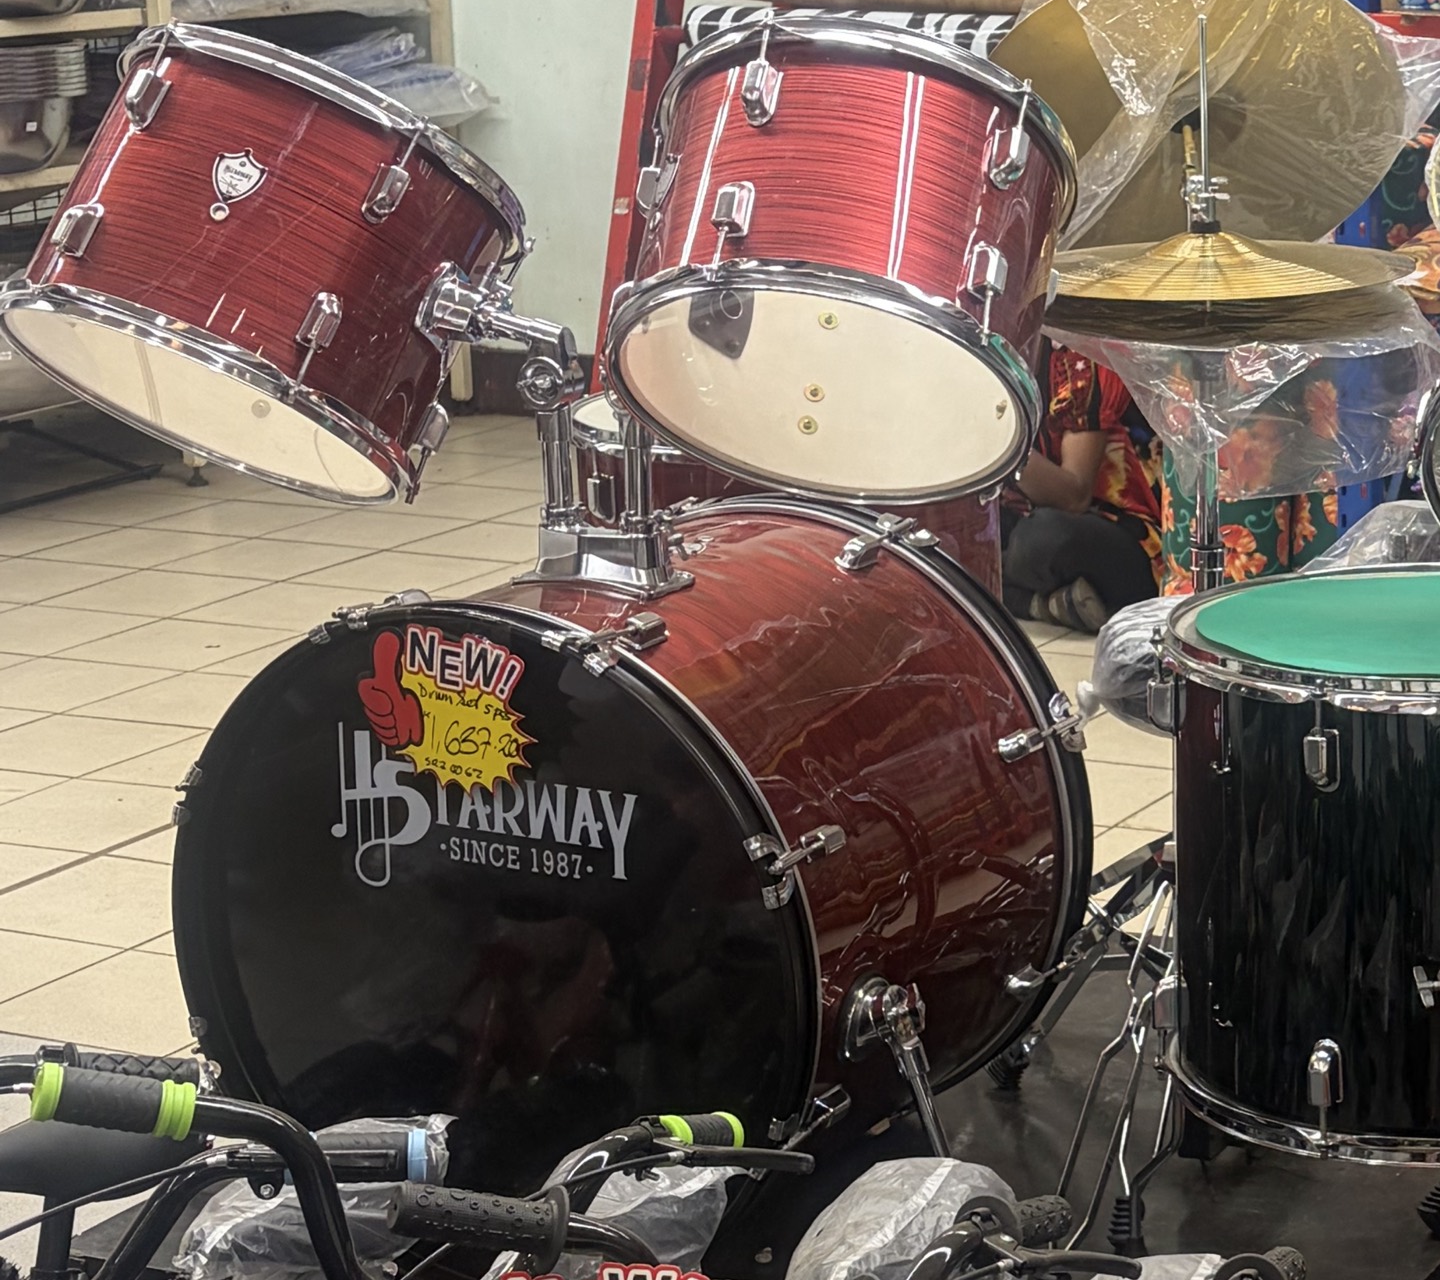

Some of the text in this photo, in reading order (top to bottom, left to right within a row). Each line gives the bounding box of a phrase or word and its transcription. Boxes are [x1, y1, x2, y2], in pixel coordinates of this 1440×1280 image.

[407, 627, 520, 699] NEW!
[417, 681, 453, 706] Drum
[355, 745, 638, 882] STARWAY
[449, 836, 582, 879] SINCE 1987
